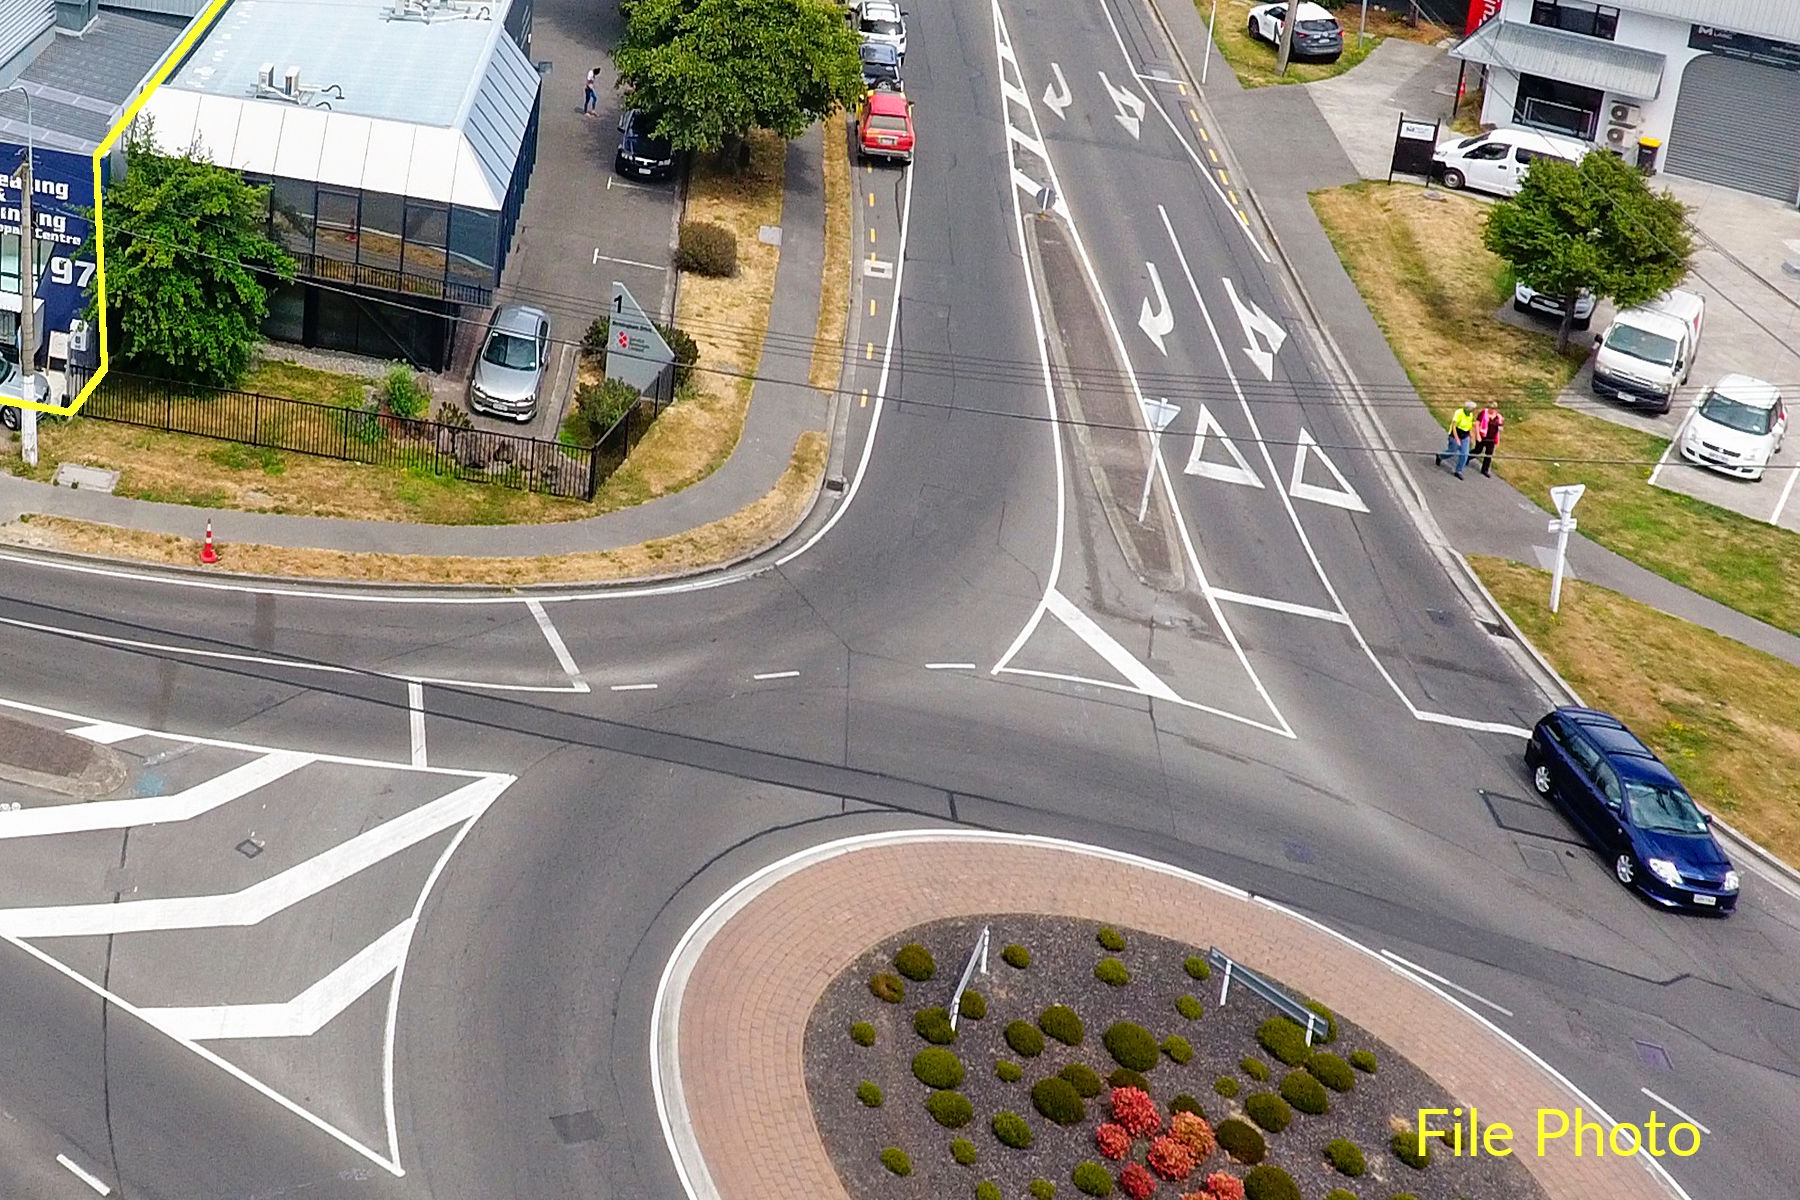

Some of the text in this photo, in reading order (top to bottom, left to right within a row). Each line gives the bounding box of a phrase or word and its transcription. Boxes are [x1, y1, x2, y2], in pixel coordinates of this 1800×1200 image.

[35, 227, 82, 246] Centre
[50, 256, 97, 288] 97
[613, 294, 623, 314] 1
